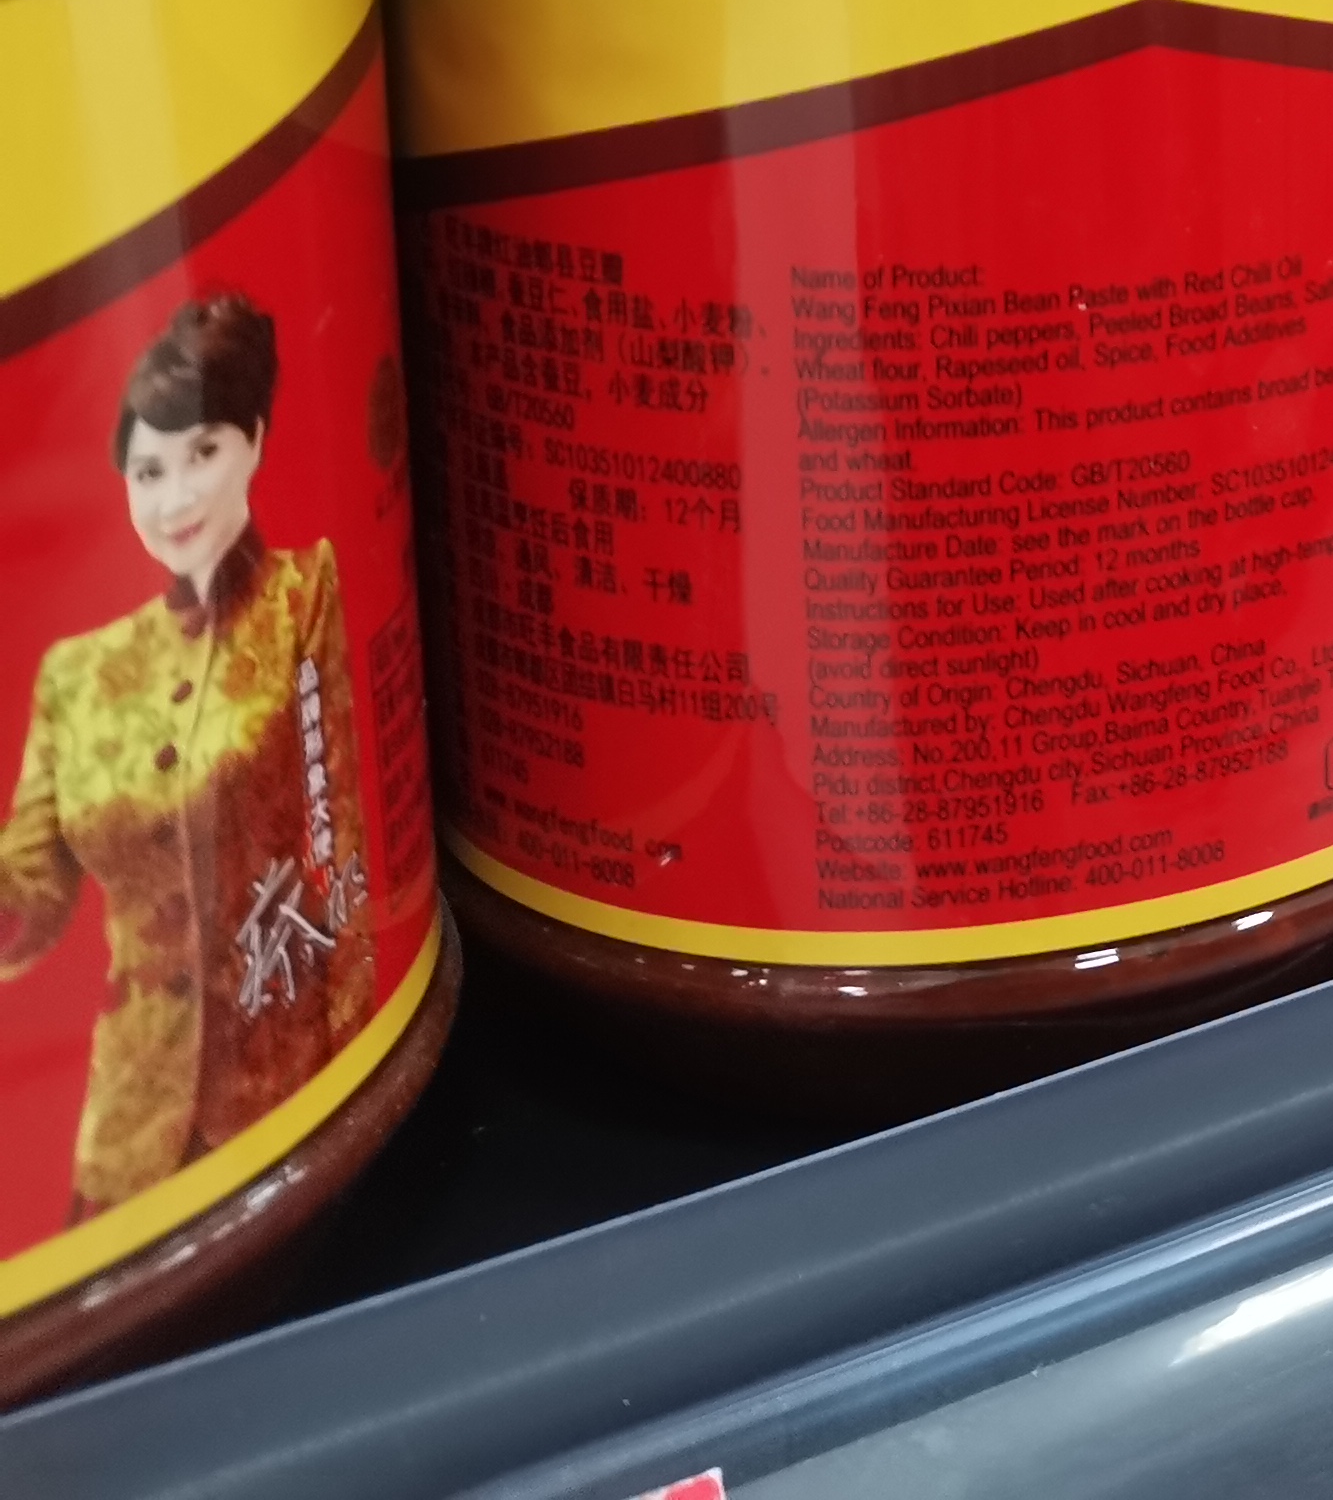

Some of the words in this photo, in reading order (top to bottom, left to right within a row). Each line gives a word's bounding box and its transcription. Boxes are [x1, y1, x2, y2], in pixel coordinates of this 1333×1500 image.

[790, 266, 857, 290] Name
[864, 267, 884, 289] of
[791, 297, 857, 325] Wang
[864, 295, 920, 325] Feng
[928, 293, 996, 318] Pixian
[1003, 290, 1061, 315] Bean
[1069, 284, 1130, 307] Paste
[1136, 278, 1177, 300] with
[1184, 271, 1224, 295] Red
[1089, 310, 1163, 338] Peeled
[1168, 300, 1229, 328] Broad
[794, 356, 865, 381] Wheat
[936, 351, 1049, 383] Rapeseed
[1165, 329, 1217, 357] Food
[1222, 316, 1308, 349] Additives
[797, 416, 887, 448] Allergen
[1034, 406, 1079, 432] This
[1086, 398, 1164, 430] product
[1170, 386, 1252, 416] contains
[1257, 371, 1310, 401] broad
[927, 381, 1023, 411] Sorbate)
[798, 451, 838, 473] and
[800, 477, 883, 502] Product
[891, 474, 991, 500] Standard
[664, 496, 743, 535] 12个月
[802, 507, 856, 532] Food
[863, 503, 1020, 533] Manufacturing
[1026, 494, 1110, 523] License
[803, 537, 938, 562] Manufacture
[1012, 533, 1050, 553] see
[1057, 524, 1090, 549] the
[1098, 516, 1149, 543] mark
[1156, 513, 1182, 535] on
[1187, 505, 1218, 530] the
[1223, 492, 1275, 523] bottle
[803, 566, 878, 597] Quality
[886, 564, 1002, 592] Guarantee
[1095, 547, 1118, 572] 12
[805, 597, 929, 622] Instructions
[936, 594, 964, 619] for
[1029, 582, 1085, 611] Used
[1092, 577, 1140, 603] after
[1145, 563, 1223, 594] cooking
[1229, 555, 1247, 579] at
[806, 625, 891, 657] Storage
[1014, 616, 1072, 642] Keep
[1078, 611, 1097, 633] in
[1102, 603, 1147, 631] cool
[1152, 595, 1191, 622] and
[1196, 587, 1227, 617] dry
[808, 683, 892, 715] Country
[900, 684, 920, 708] of
[1210, 638, 1268, 667] China
[880, 654, 940, 679] direct
[946, 646, 1040, 677] sunlight)
[810, 712, 958, 739] Manufactured
[1003, 697, 1103, 730] Chengdu
[1107, 678, 1210, 714] Wangfeng
[1217, 665, 1266, 694] Food
[813, 773, 858, 797] Pidu
[927, 824, 1008, 852] 611745
[818, 886, 900, 911] National
[911, 882, 991, 909] Service
[1085, 841, 1226, 888] 400-011-8008
